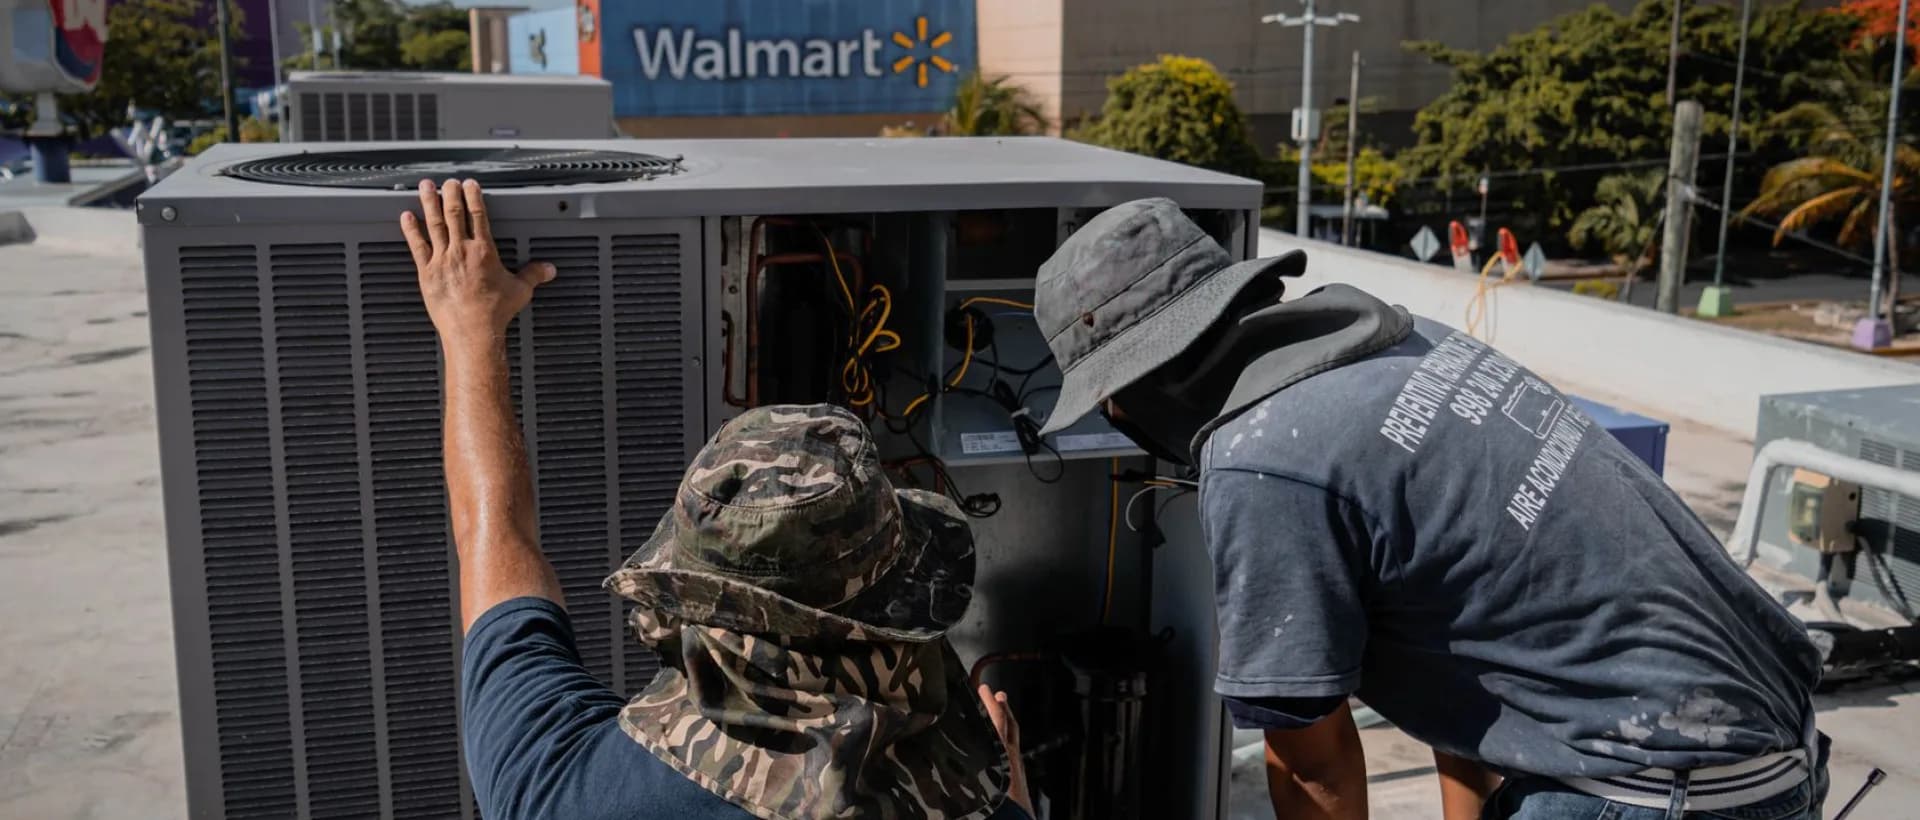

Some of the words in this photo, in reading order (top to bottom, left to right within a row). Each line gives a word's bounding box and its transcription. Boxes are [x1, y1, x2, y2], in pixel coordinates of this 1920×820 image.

[633, 28, 882, 80] Walmart
[1449, 387, 1493, 425] 998
[1465, 371, 1504, 399] 240
[1506, 483, 1546, 530] AIRE
